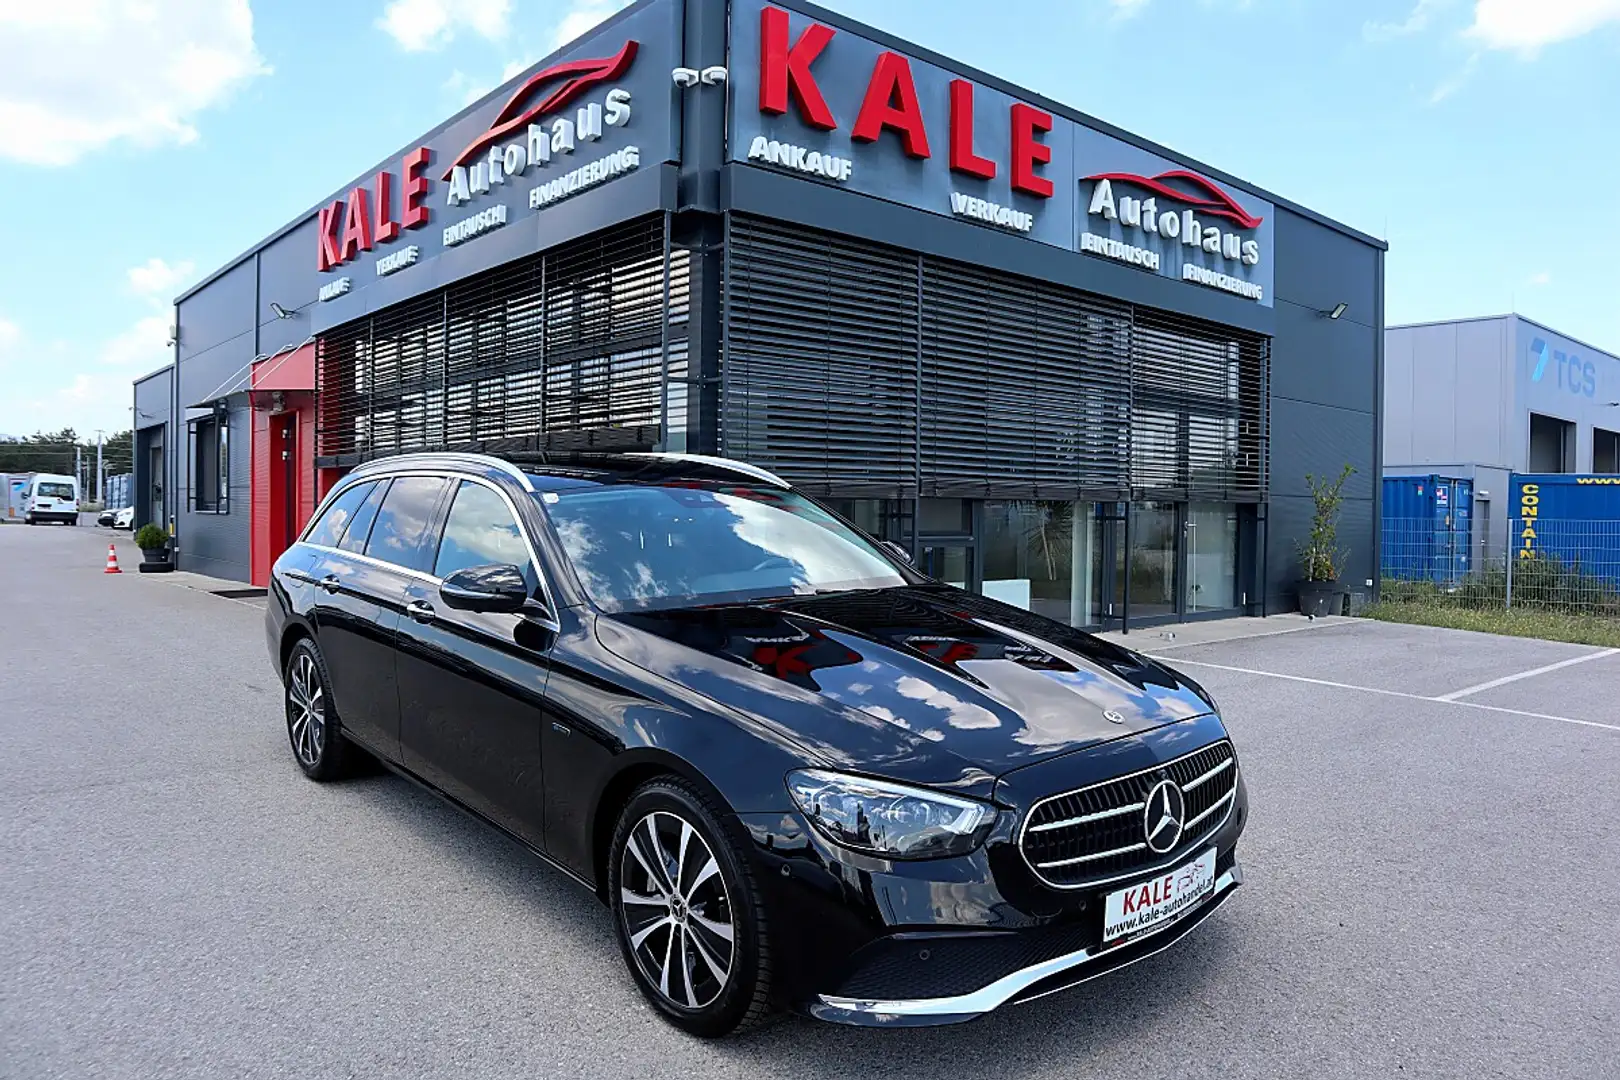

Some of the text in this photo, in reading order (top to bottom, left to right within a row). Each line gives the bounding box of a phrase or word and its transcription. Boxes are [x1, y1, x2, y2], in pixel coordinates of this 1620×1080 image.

[317, 87, 633, 272] KALE Autohaus
[529, 145, 640, 209] FINANZIERUNG
[759, 6, 1260, 265] KALE Autohaus
[748, 136, 1263, 300] ANKAUF VERKAUF EINTAUSCH FINANZIERUNG
[1553, 349, 1596, 398] TCS
[1123, 875, 1174, 916] KALE
